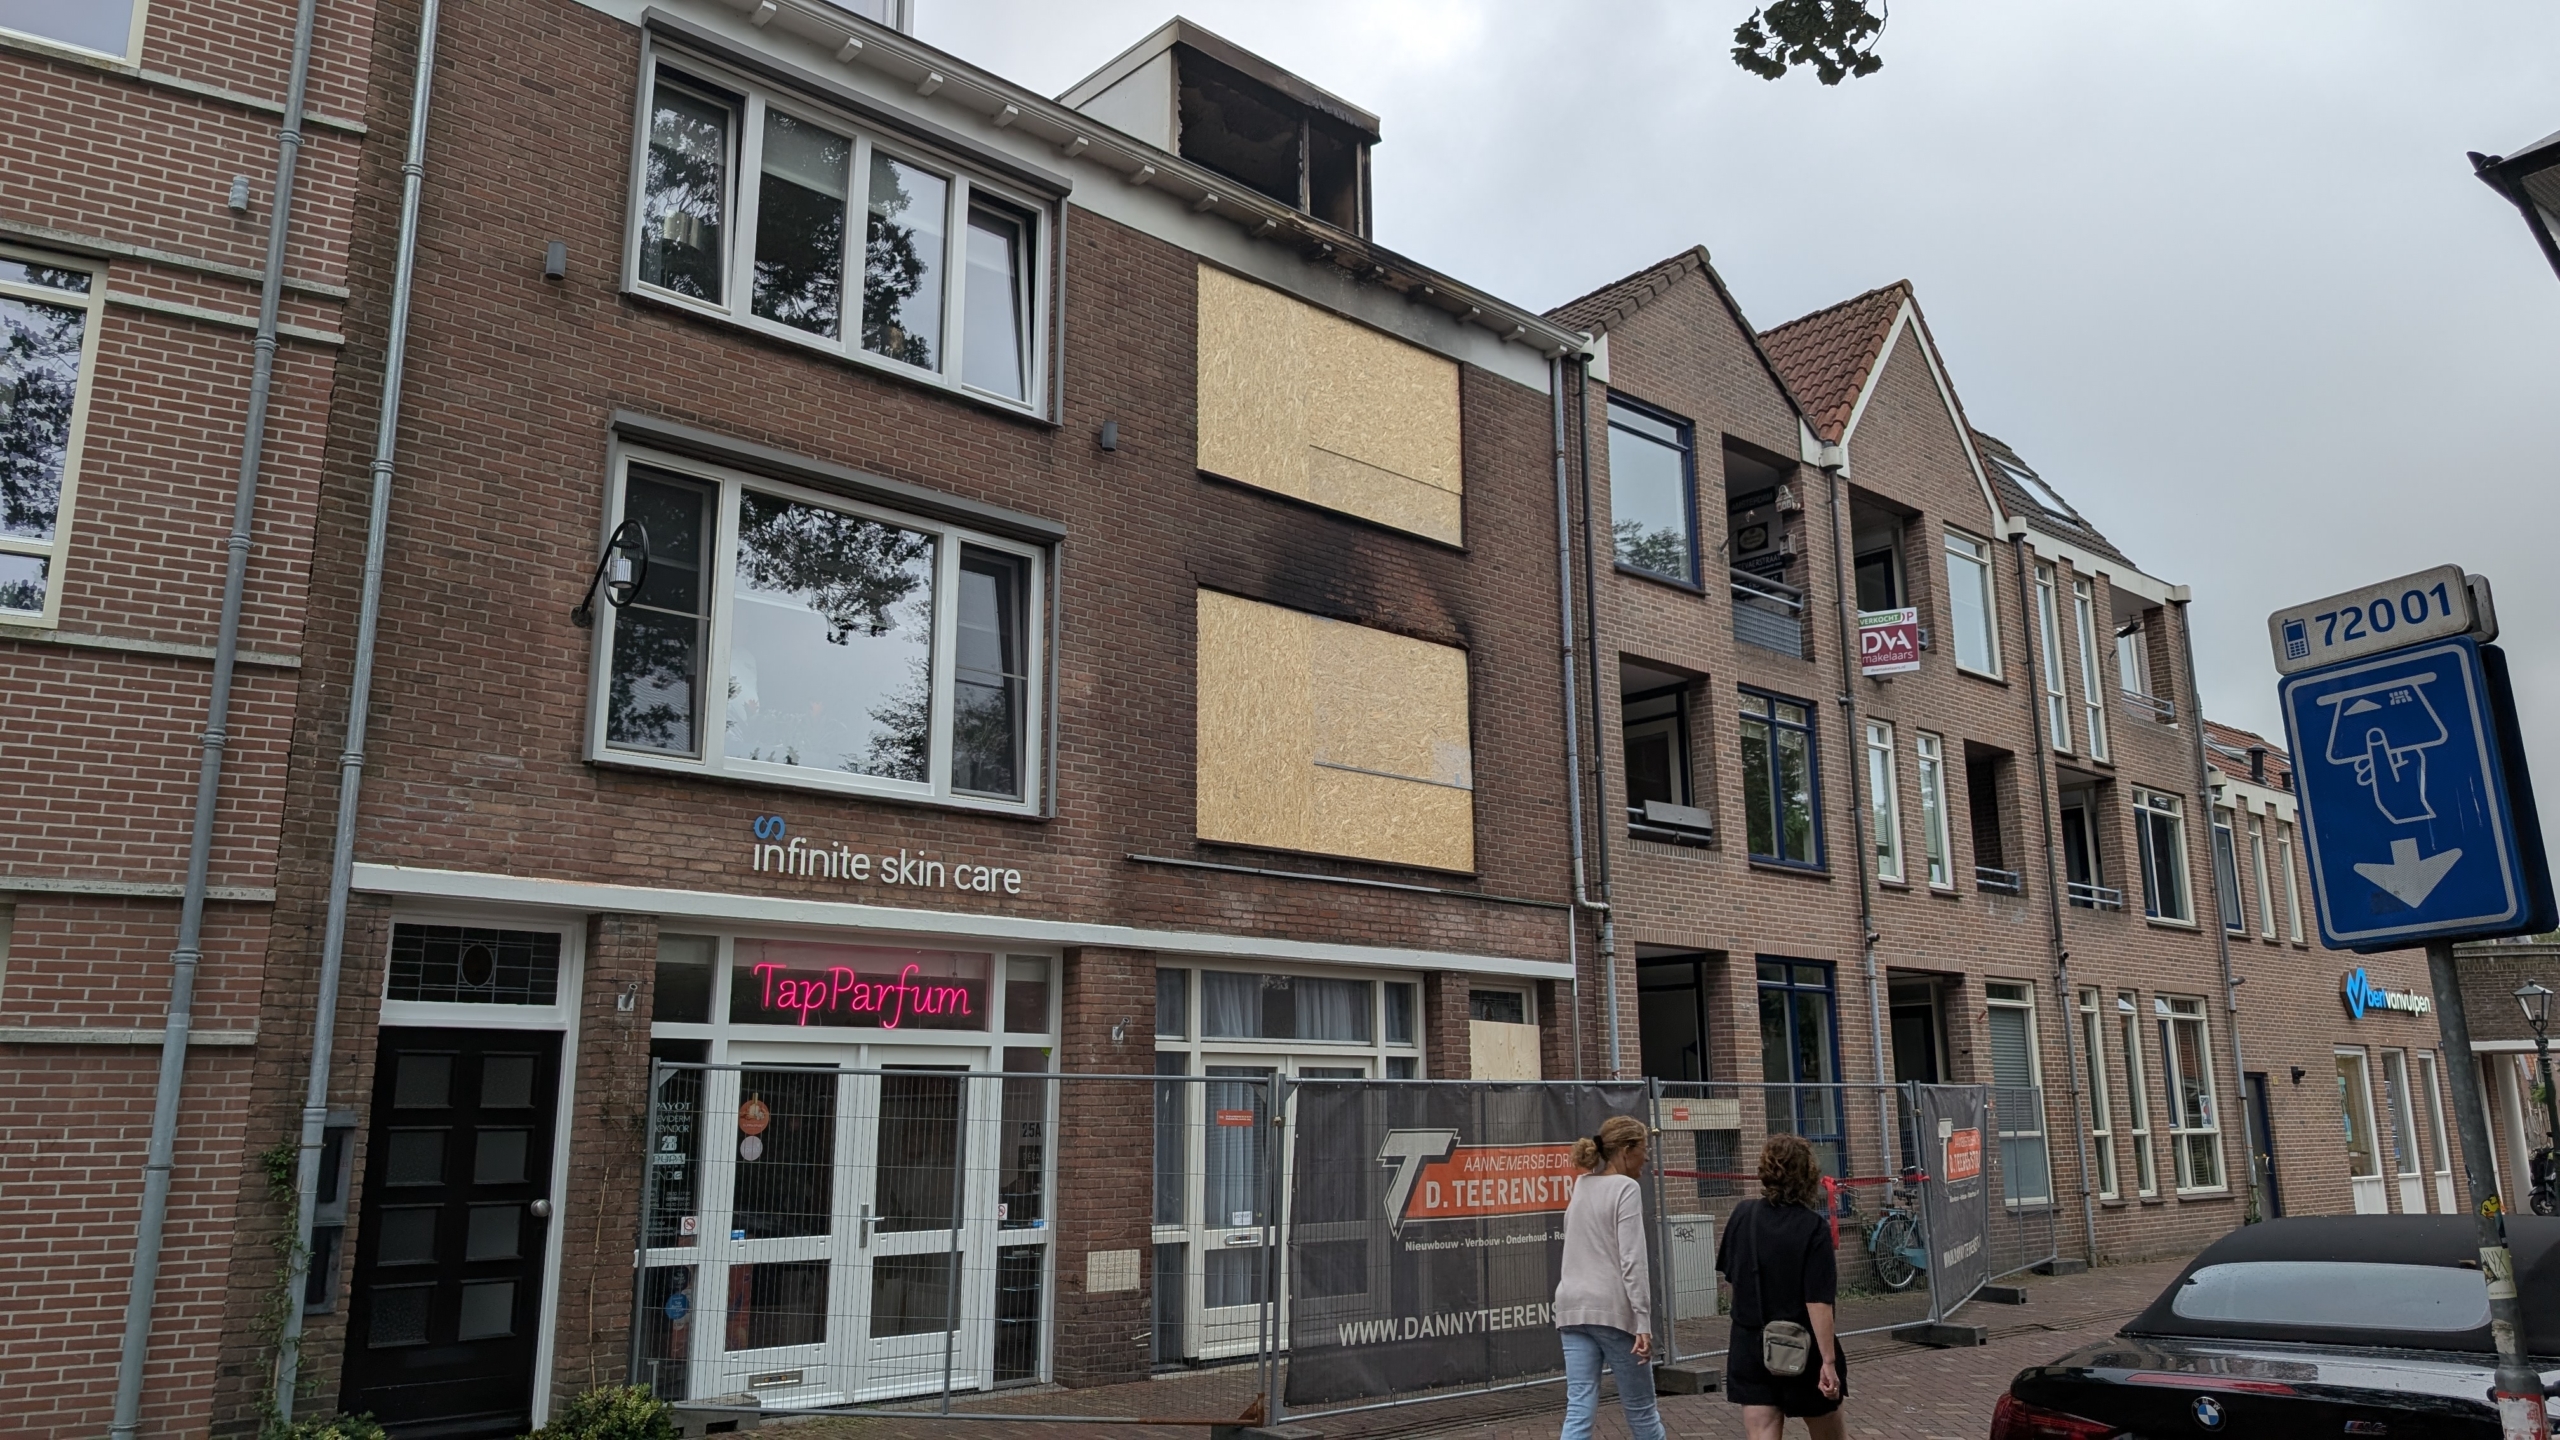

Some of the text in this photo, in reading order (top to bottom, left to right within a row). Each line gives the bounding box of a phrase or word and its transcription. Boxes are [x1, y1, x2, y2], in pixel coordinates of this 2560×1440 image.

[1859, 614, 1899, 626] VERKOCHT
[2316, 582, 2453, 647] 72001
[1863, 651, 1914, 663] makelaars
[753, 837, 1022, 895] infinite skin care
[753, 962, 972, 1029] TapParfum
[1022, 1122, 1042, 1138] 25A
[1464, 1153, 1573, 1172] AANNEMERSBEDR
[1425, 1175, 1574, 1209] D. TEERENSTR
[1405, 1240, 1459, 1251] Nieuwbouw
[1465, 1236, 1500, 1248] Verbouw
[1506, 1232, 1547, 1244] Onderhoud
[1554, 1231, 1565, 1241] Re
[1339, 1302, 1557, 1347] WWW.DANNYTEERENS
